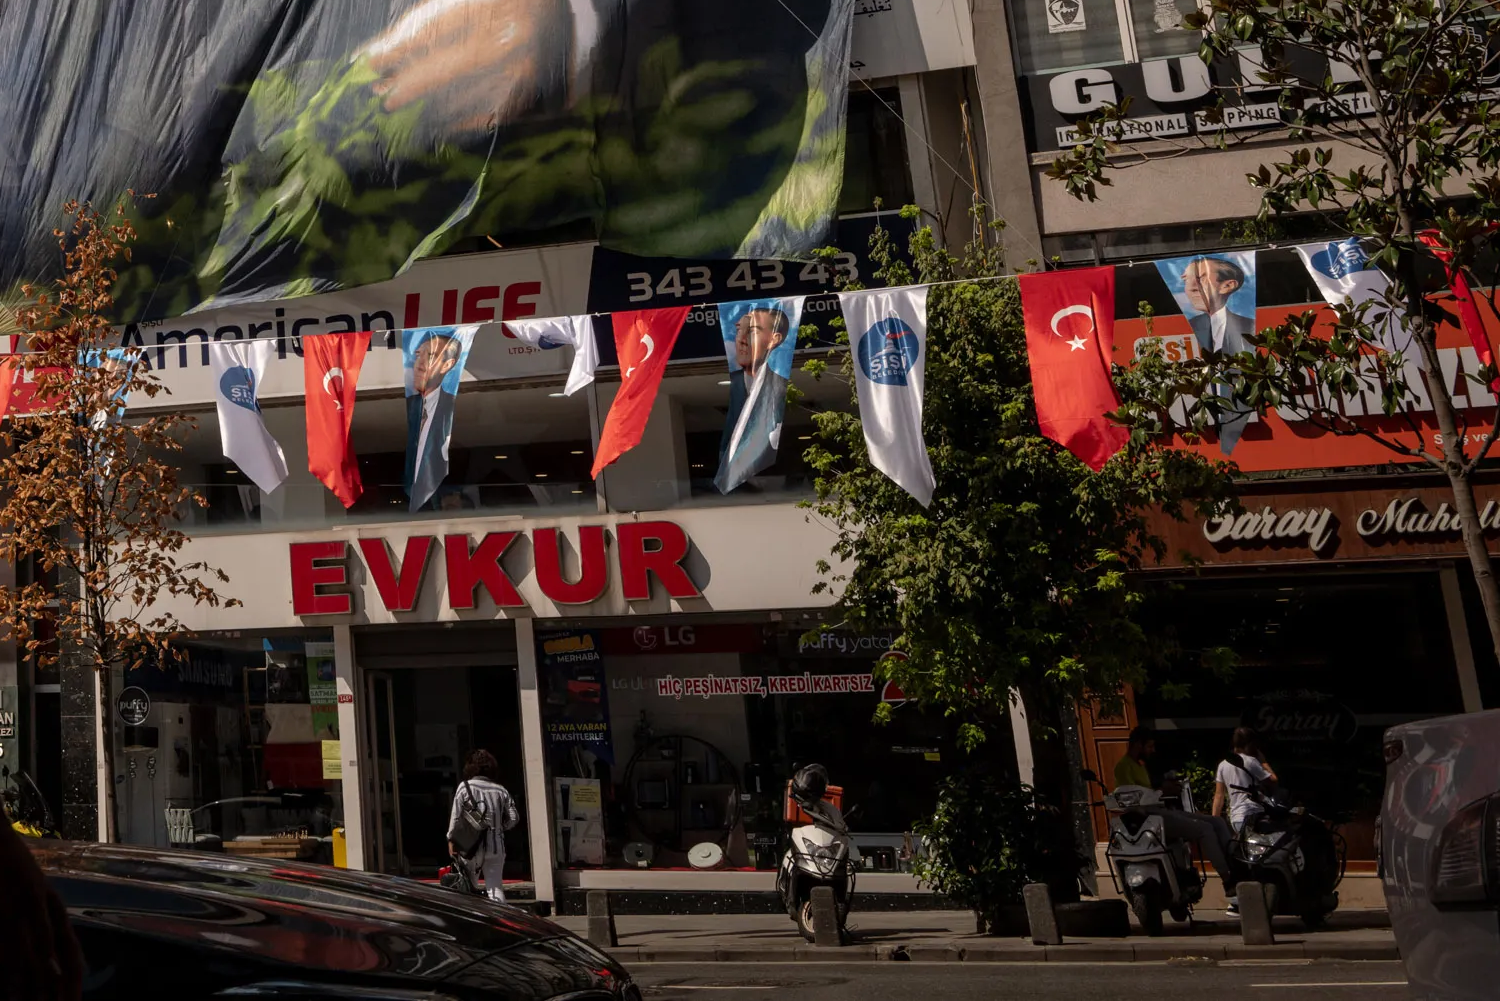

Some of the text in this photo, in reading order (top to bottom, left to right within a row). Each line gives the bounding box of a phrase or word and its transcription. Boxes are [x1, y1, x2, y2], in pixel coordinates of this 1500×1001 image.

[626, 266, 713, 303] 343
[726, 260, 786, 292] 43
[1203, 498, 1332, 552] Saray
[290, 521, 704, 615] EVKUR
[664, 625, 696, 646] LG
[557, 652, 600, 663] MERHABA
[177, 659, 233, 688] SAMSUNG
[658, 676, 682, 699] HİÇ
[768, 672, 812, 695] KREDİ
[812, 674, 875, 694] KARTSIZ
[119, 698, 148, 713] puffy
[576, 722, 607, 732] VARAN
